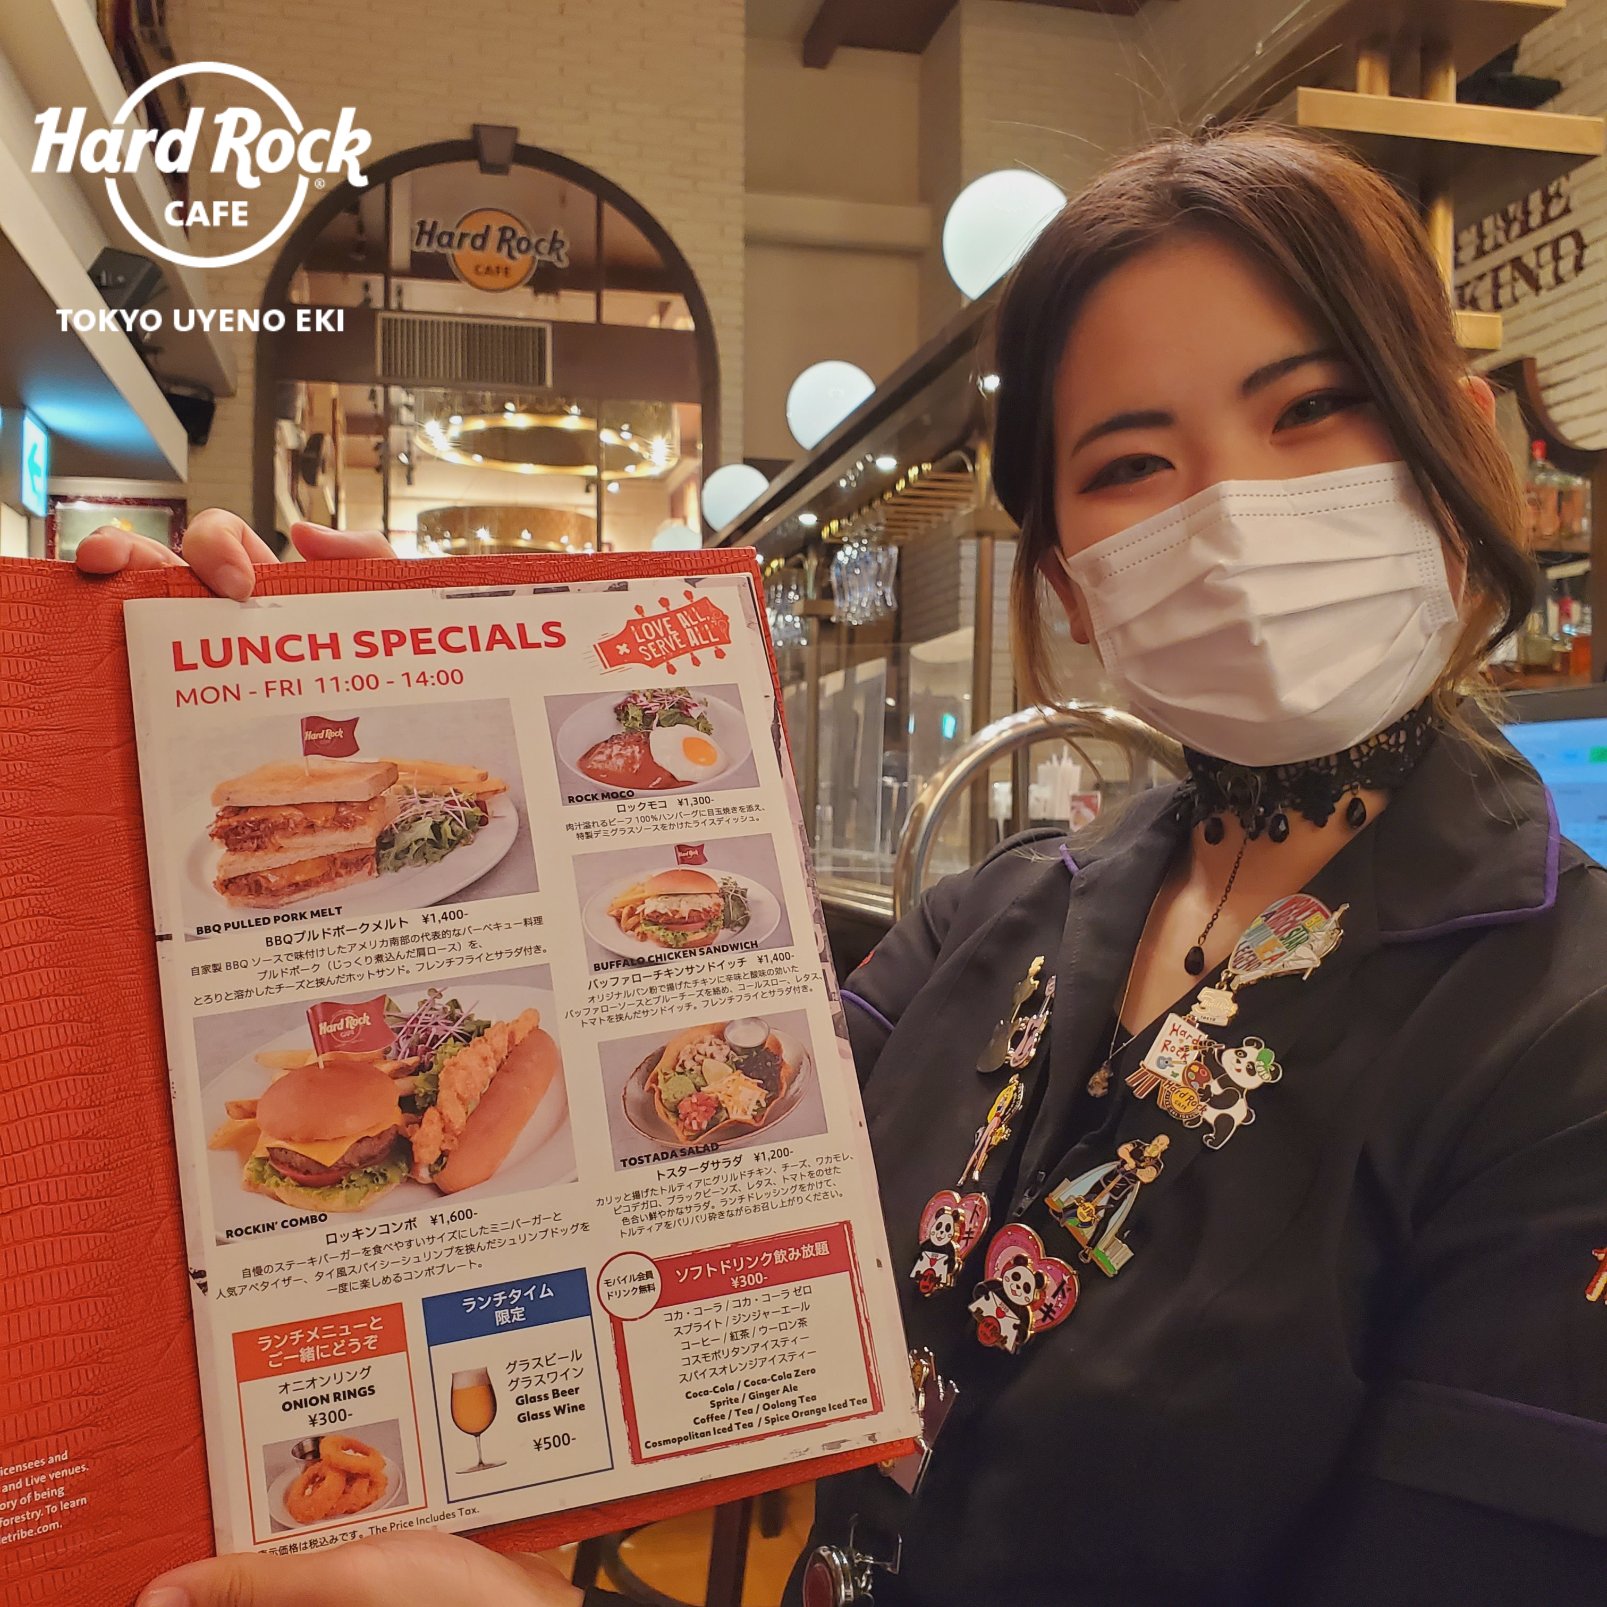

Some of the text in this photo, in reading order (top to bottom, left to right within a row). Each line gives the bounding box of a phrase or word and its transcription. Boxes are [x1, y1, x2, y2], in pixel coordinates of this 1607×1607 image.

[415, 219, 565, 262] Hard Rock
[474, 264, 511, 278] CAFE
[631, 607, 710, 643] LOVE ALL,
[172, 621, 567, 672] LUNCH SPECIALS
[638, 624, 719, 661] SERVE ALL
[176, 683, 241, 708] MON
[265, 679, 302, 699] FRI
[315, 674, 380, 694] 11:00
[402, 669, 464, 688] 14:00
[305, 728, 343, 741] Hard Rock
[568, 790, 635, 804] ROCK MOCO
[617, 796, 714, 813] ロックモコ ¥1,300-
[196, 906, 343, 935] BBQ PULLED PORK MELT
[422, 909, 469, 925] ¥1,400-
[225, 959, 249, 971] BBQ
[593, 940, 759, 972] BUFFALO CHICKEN SANDWICH
[588, 952, 795, 990] バッファローチキンサンドイッチ ¥1,400-
[319, 1013, 371, 1035] Hard Rock
[1169, 1022, 1203, 1045] Hard
[1161, 1039, 1189, 1060] Rock
[620, 1142, 719, 1167] TOSTADA SALAD
[656, 1147, 794, 1181] トスターダサラダ ¥1,200-
[226, 1213, 328, 1238] ROCKIN' COMBO
[326, 1208, 478, 1245] ロッキンコンボ ¥1,600-
[675, 1240, 830, 1283] ソフトドリンク飲み放題
[603, 1270, 654, 1287] モバイル会員
[730, 1273, 768, 1289] ¥300-
[462, 1283, 554, 1313] ランチタイム
[606, 1283, 656, 1301] ドリンク無料
[495, 1306, 526, 1327] 限定
[673, 1318, 723, 1337] スプライト
[732, 1301, 810, 1325] ジンジャーエール
[258, 1316, 384, 1352] ランチメニューと
[681, 1334, 721, 1351] コーヒー
[730, 1330, 750, 1341] 紅茶
[758, 1317, 808, 1336] ウーロン茶
[268, 1334, 378, 1368] ご一緒にどうぞ
[505, 1349, 583, 1375] グラスビール
[681, 1335, 809, 1367] コスモポリタンアイスティー
[278, 1365, 372, 1395] オニオンリング
[508, 1367, 584, 1393] グラスワイン
[678, 1350, 817, 1384] スパイスオレンジアイスティー
[515, 1386, 580, 1407] Glass Beer
[685, 1380, 735, 1400] Coca-Cola
[743, 1371, 793, 1388] Coca-Cola
[794, 1367, 816, 1379] Zero
[709, 1396, 739, 1409] Sprite
[748, 1388, 781, 1403] Ginger
[782, 1383, 798, 1394] Ale
[281, 1385, 376, 1412] ONION RINGS
[693, 1412, 726, 1426] Coffee
[734, 1407, 753, 1417] Tea
[762, 1398, 797, 1414] Oolong
[798, 1394, 817, 1404] Tea
[308, 1408, 353, 1427] ¥300-
[517, 1402, 586, 1424] Glass Wine
[644, 1429, 712, 1450] Cosmopolitan
[713, 1423, 734, 1435] Iced
[735, 1420, 753, 1431] Tea
[764, 1413, 790, 1429] Spice
[791, 1407, 827, 1421] Orange
[828, 1400, 848, 1412] Iced
[849, 1396, 868, 1407] Tea
[533, 1432, 576, 1452] ¥500-
[47, 1450, 69, 1465] and
[2, 1464, 89, 1493] and Live venues.
[20, 1493, 32, 1505] of
[34, 1486, 65, 1502] being
[45, 1504, 58, 1515] To
[60, 1497, 87, 1510] learn
[369, 1525, 388, 1535] The
[389, 1520, 414, 1532] Price
[416, 1511, 456, 1527] Includes
[458, 1508, 480, 1517] Tax.
